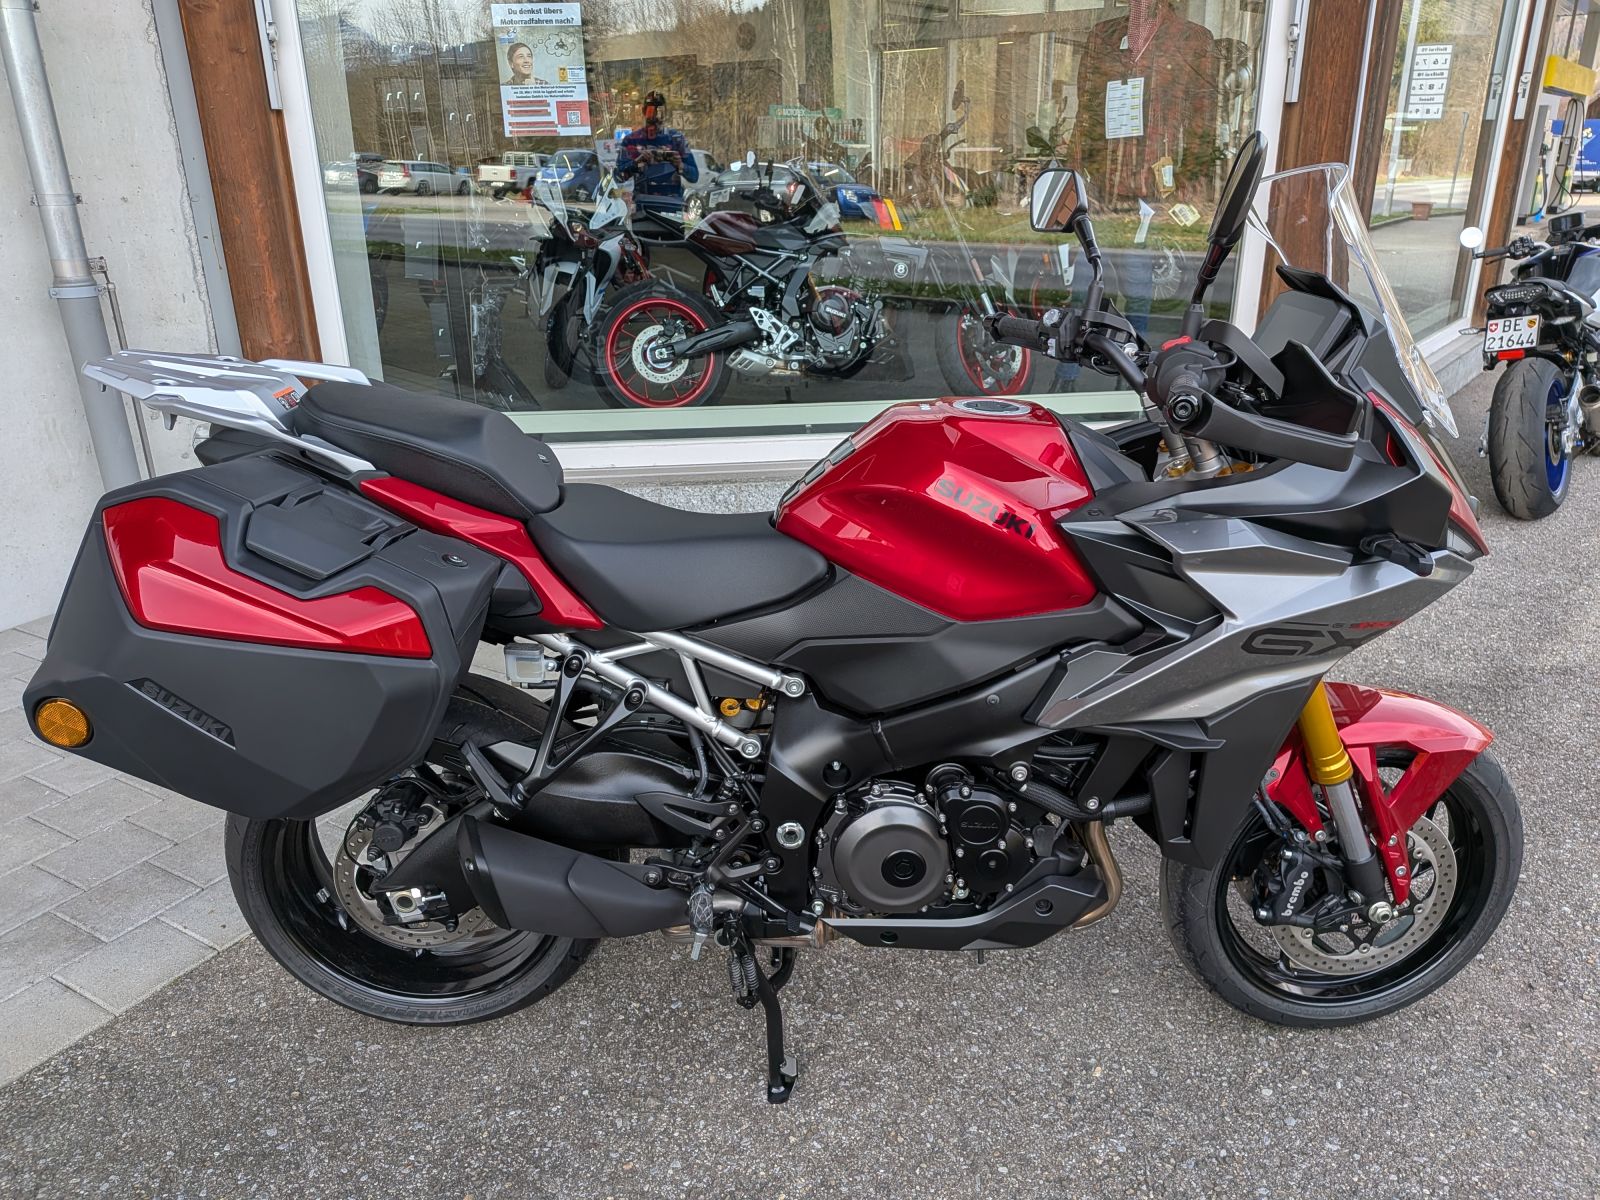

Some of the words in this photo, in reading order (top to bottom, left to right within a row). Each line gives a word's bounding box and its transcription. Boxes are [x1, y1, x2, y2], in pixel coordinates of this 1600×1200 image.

[518, 7, 542, 15] denkst
[500, 17, 553, 26] Motorradfahren
[554, 17, 574, 25] nach?
[825, 306, 848, 319] SUZUKI
[1502, 318, 1524, 333] BE
[1486, 332, 1535, 350] 21644
[935, 478, 1037, 540] SUZUKI
[140, 680, 231, 741] SUZUKI
[1280, 871, 1309, 917] brembo
